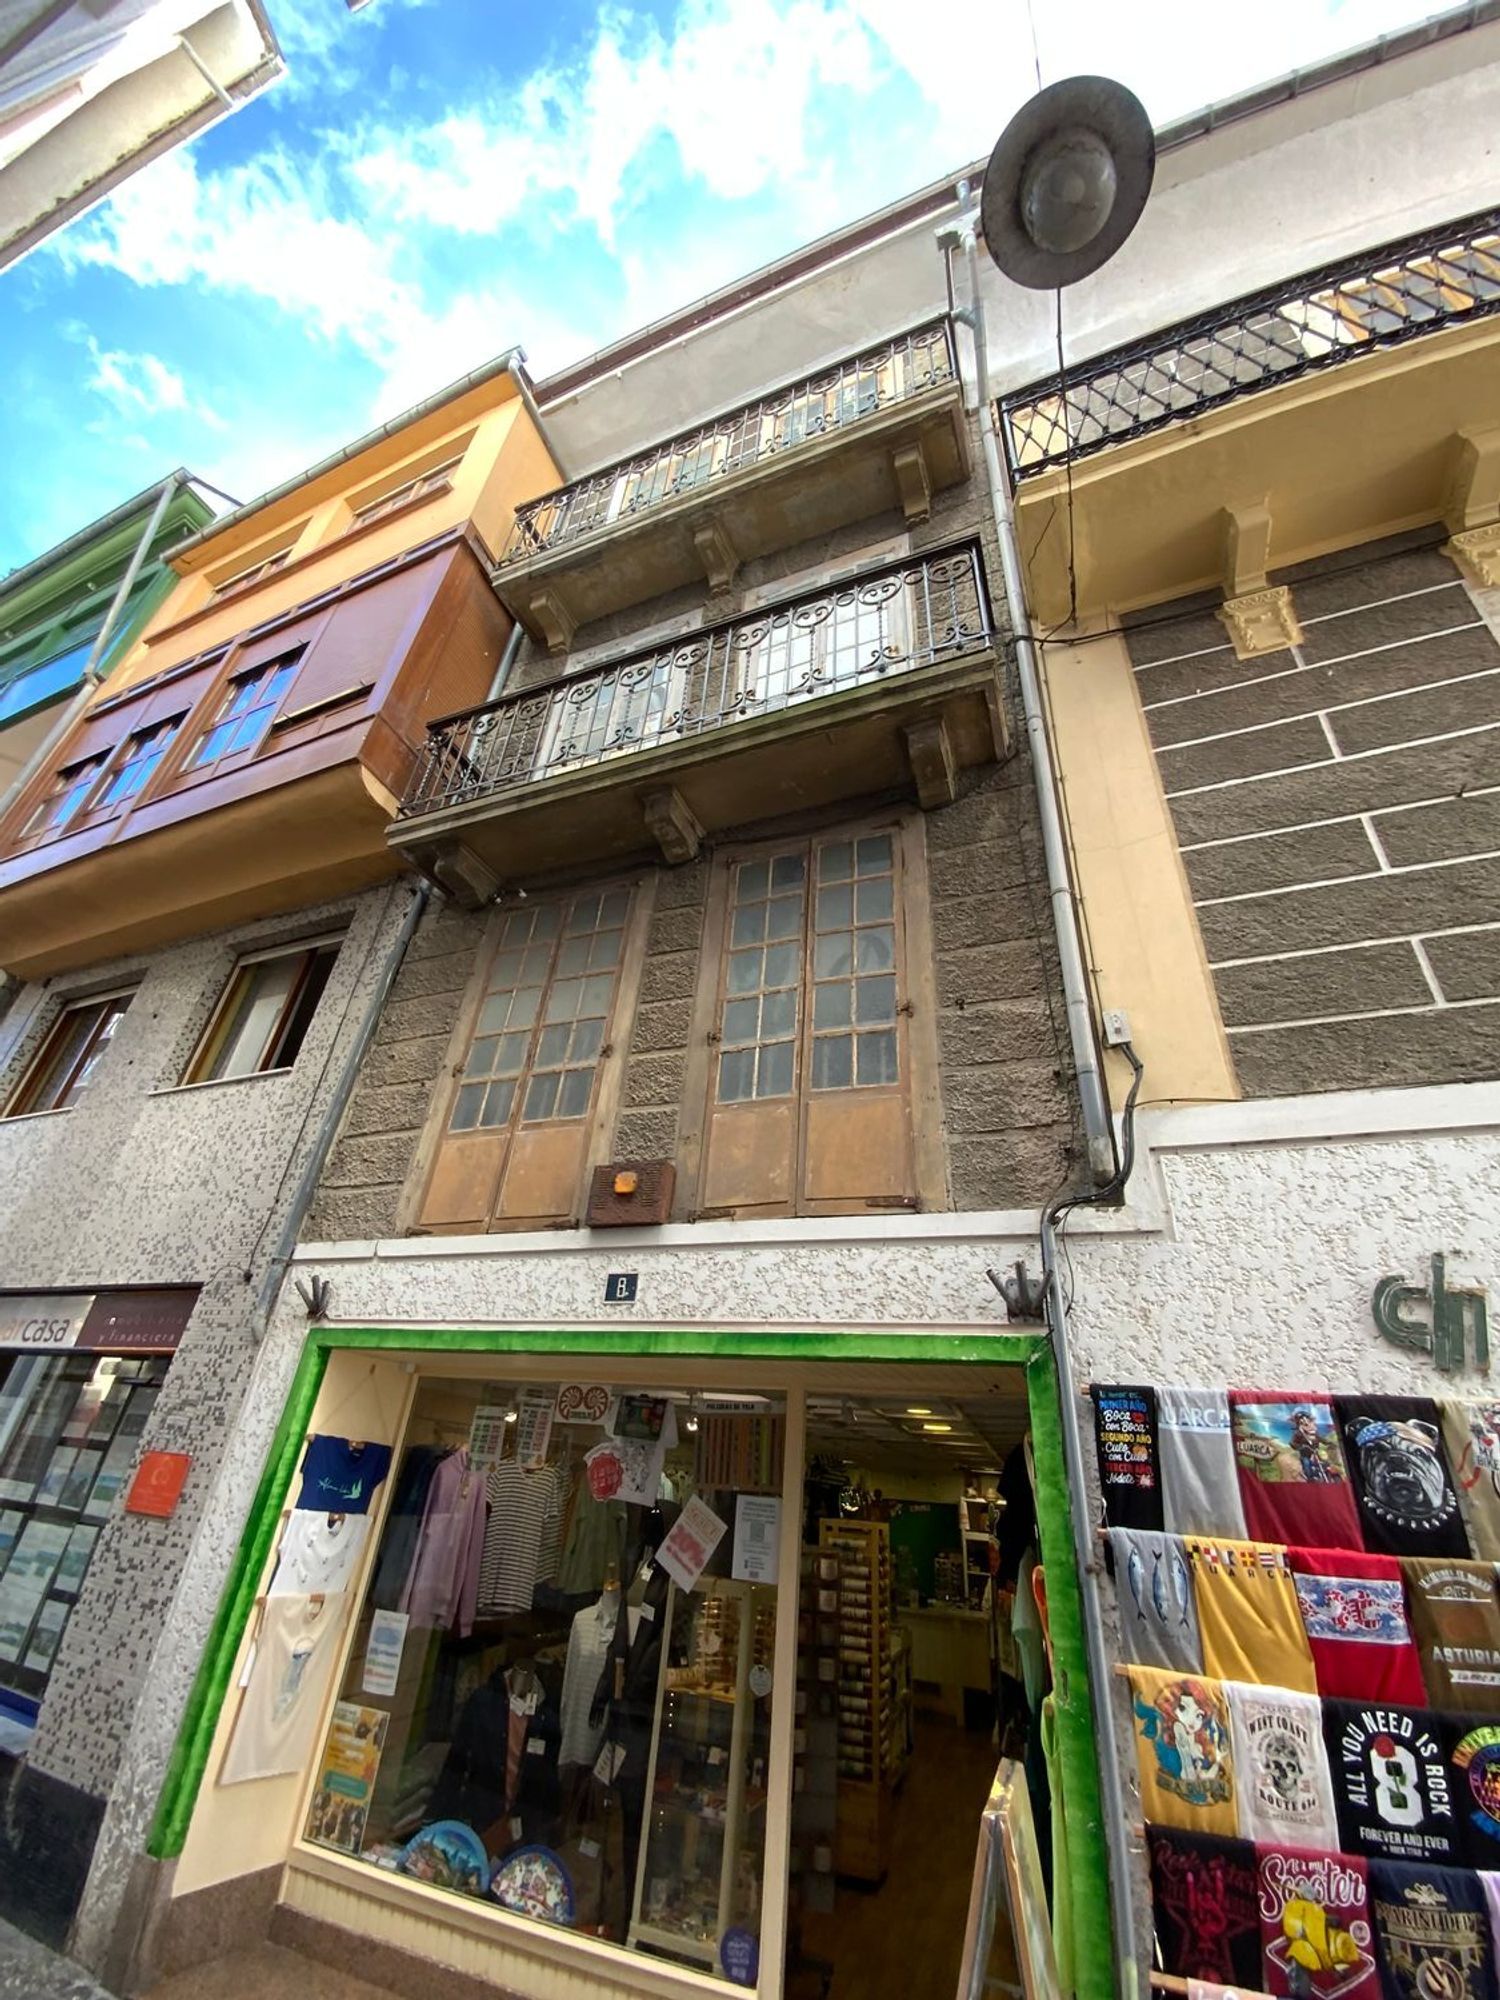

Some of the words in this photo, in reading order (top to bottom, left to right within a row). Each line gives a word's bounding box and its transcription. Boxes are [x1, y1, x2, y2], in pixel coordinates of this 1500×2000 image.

[1103, 1410, 1131, 1423] Boca
[1121, 1421, 1146, 1433] Boca
[1101, 1432, 1135, 1443] SEGUNDO
[1361, 1711, 1413, 1738] NEED
[1341, 1722, 1366, 1762] YOU
[1415, 1733, 1438, 1757] IS
[1345, 1771, 1369, 1807] ALL
[1425, 1764, 1452, 1817] ROCK
[1359, 1825, 1401, 1845] FOREVER
[1402, 1832, 1423, 1847] AND
[1424, 1835, 1450, 1851] EVER
[1258, 1853, 1366, 1922] Scooter
